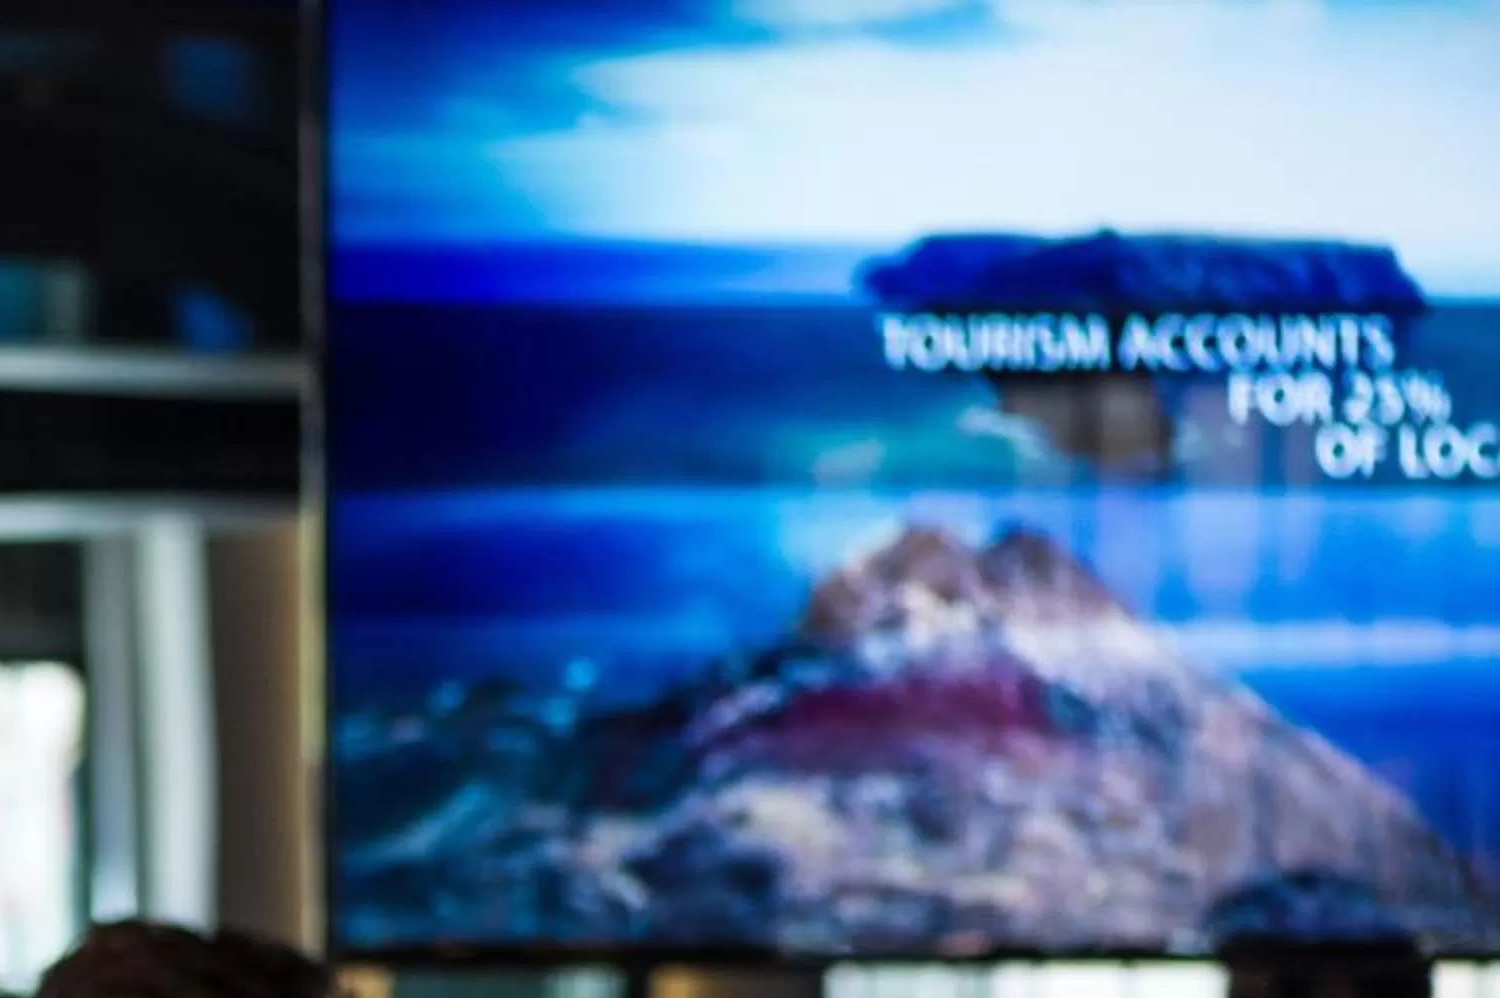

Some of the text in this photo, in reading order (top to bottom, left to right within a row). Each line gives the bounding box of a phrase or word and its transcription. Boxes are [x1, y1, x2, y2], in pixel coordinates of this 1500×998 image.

[881, 313, 1395, 371] TOURISM ACCOUNTS
[1228, 371, 1333, 426] FOR
[1315, 421, 1500, 479] OF LOC
